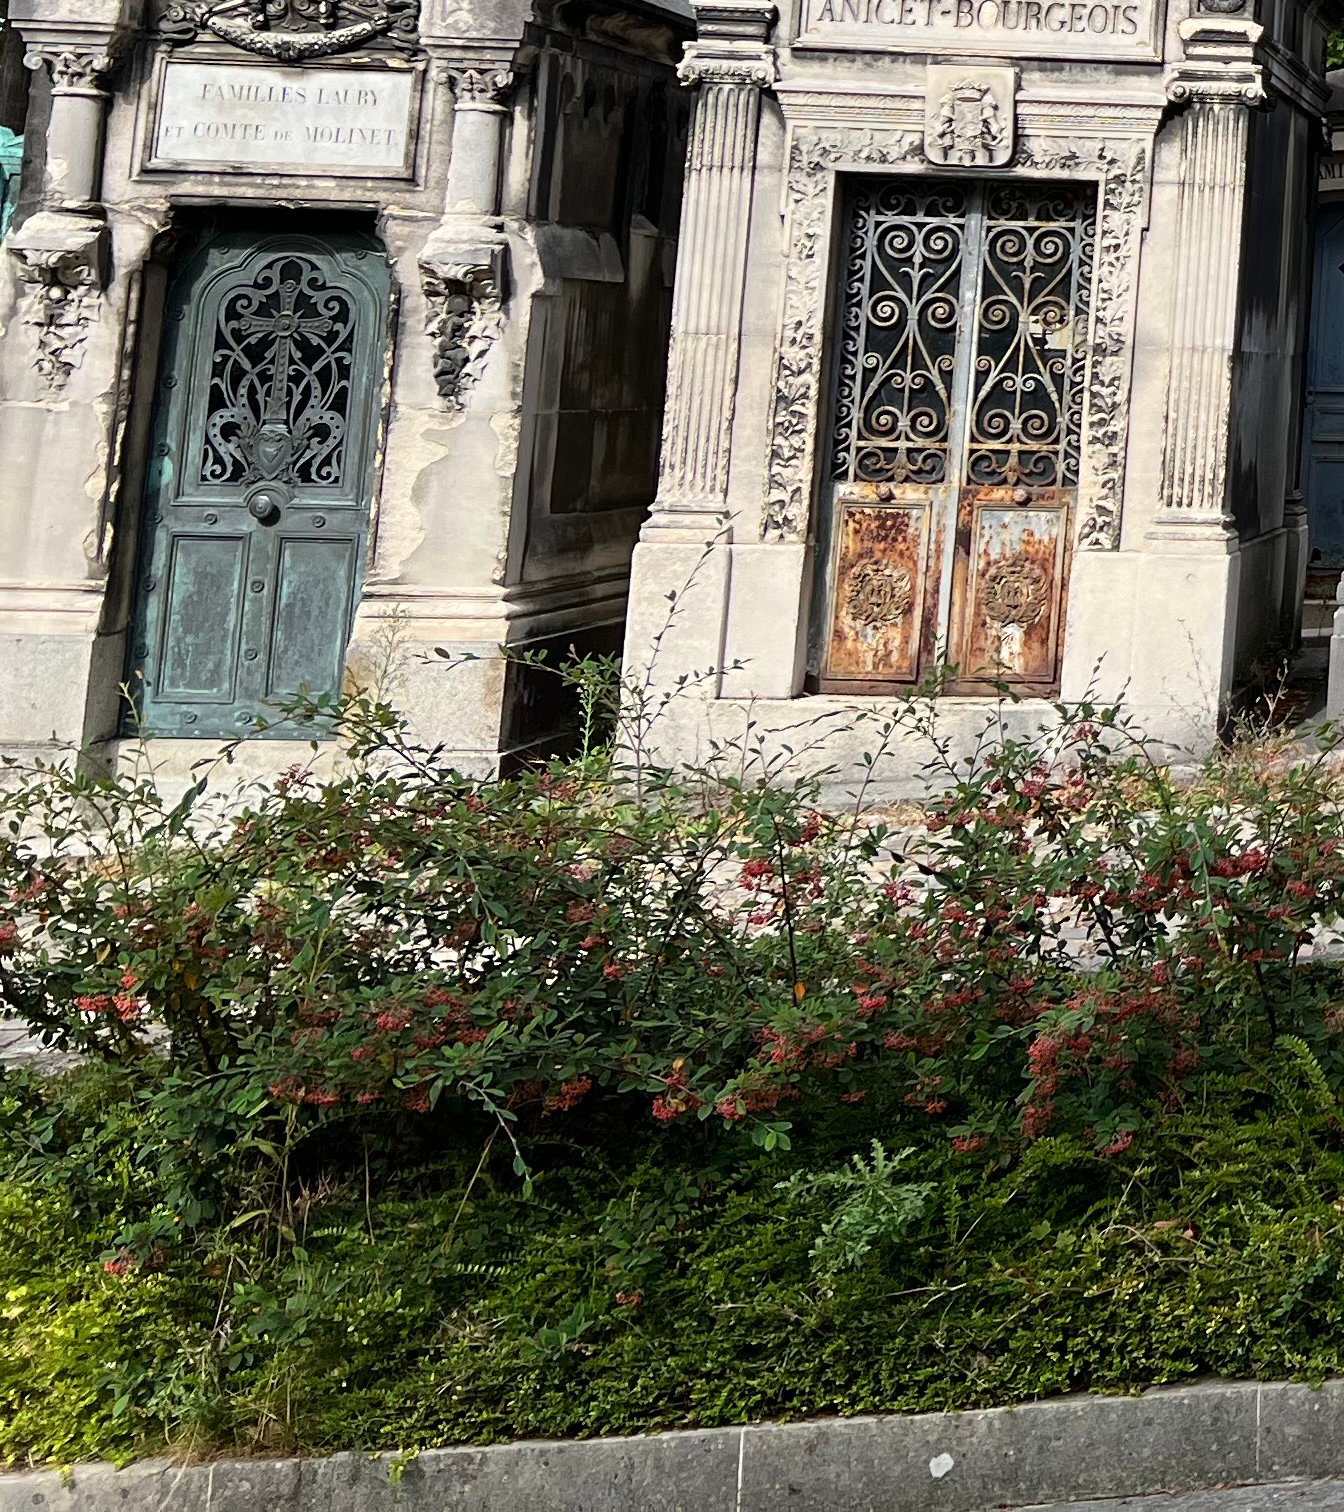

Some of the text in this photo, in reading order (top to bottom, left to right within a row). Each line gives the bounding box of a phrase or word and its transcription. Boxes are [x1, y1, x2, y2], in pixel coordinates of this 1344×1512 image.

[202, 83, 307, 104] FAMILLES
[164, 126, 184, 138] ET
[193, 122, 266, 141] COMTE
[274, 130, 292, 141] DE
